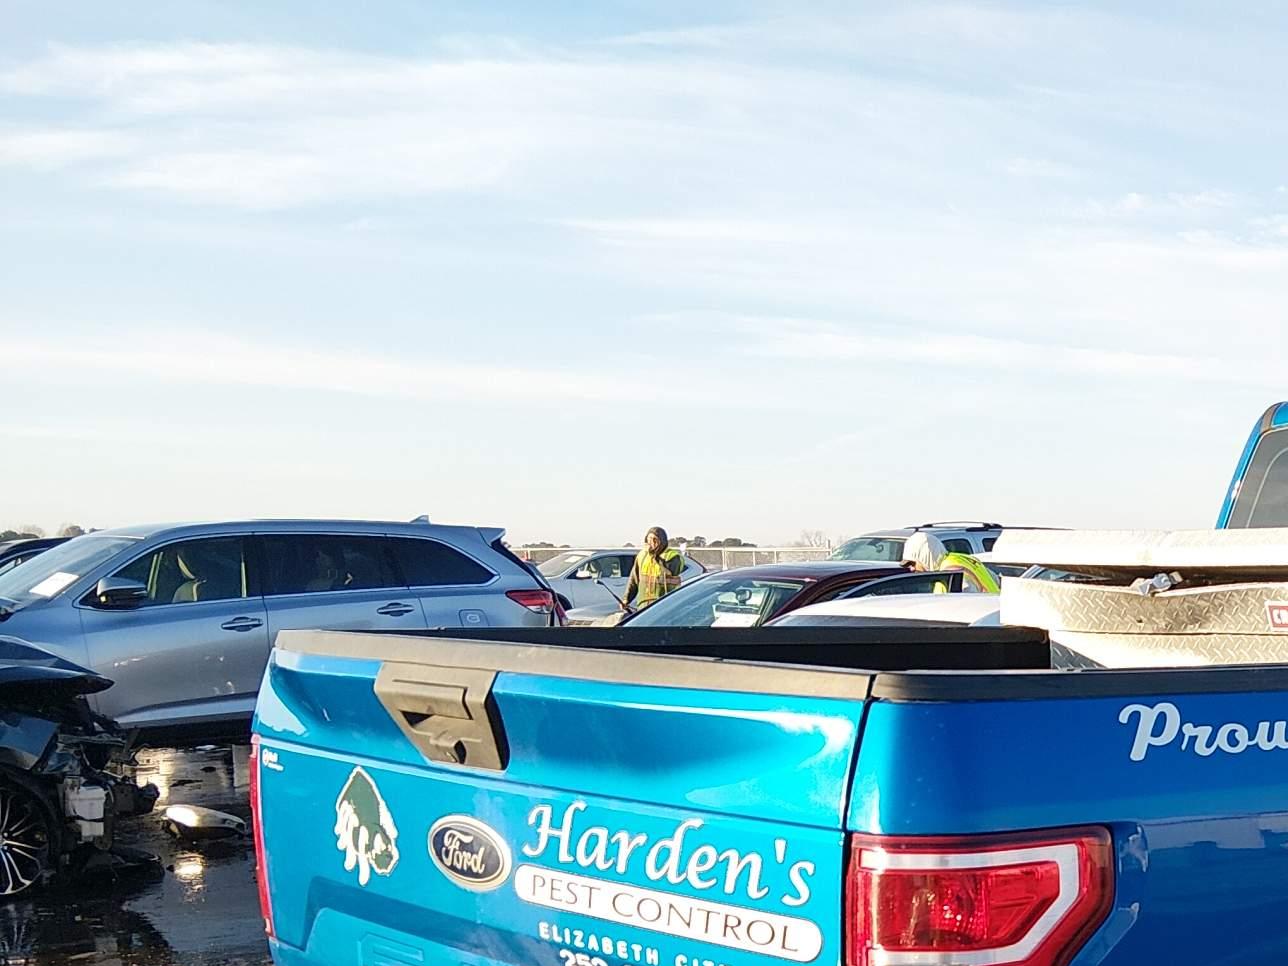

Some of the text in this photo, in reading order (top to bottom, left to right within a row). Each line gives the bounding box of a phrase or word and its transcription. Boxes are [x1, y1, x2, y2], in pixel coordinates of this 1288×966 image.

[442, 830, 487, 875] Ford
[522, 800, 816, 907] Harden's
[531, 874, 800, 953] PEST CONTROL
[538, 921, 661, 966] ELIZABETH
